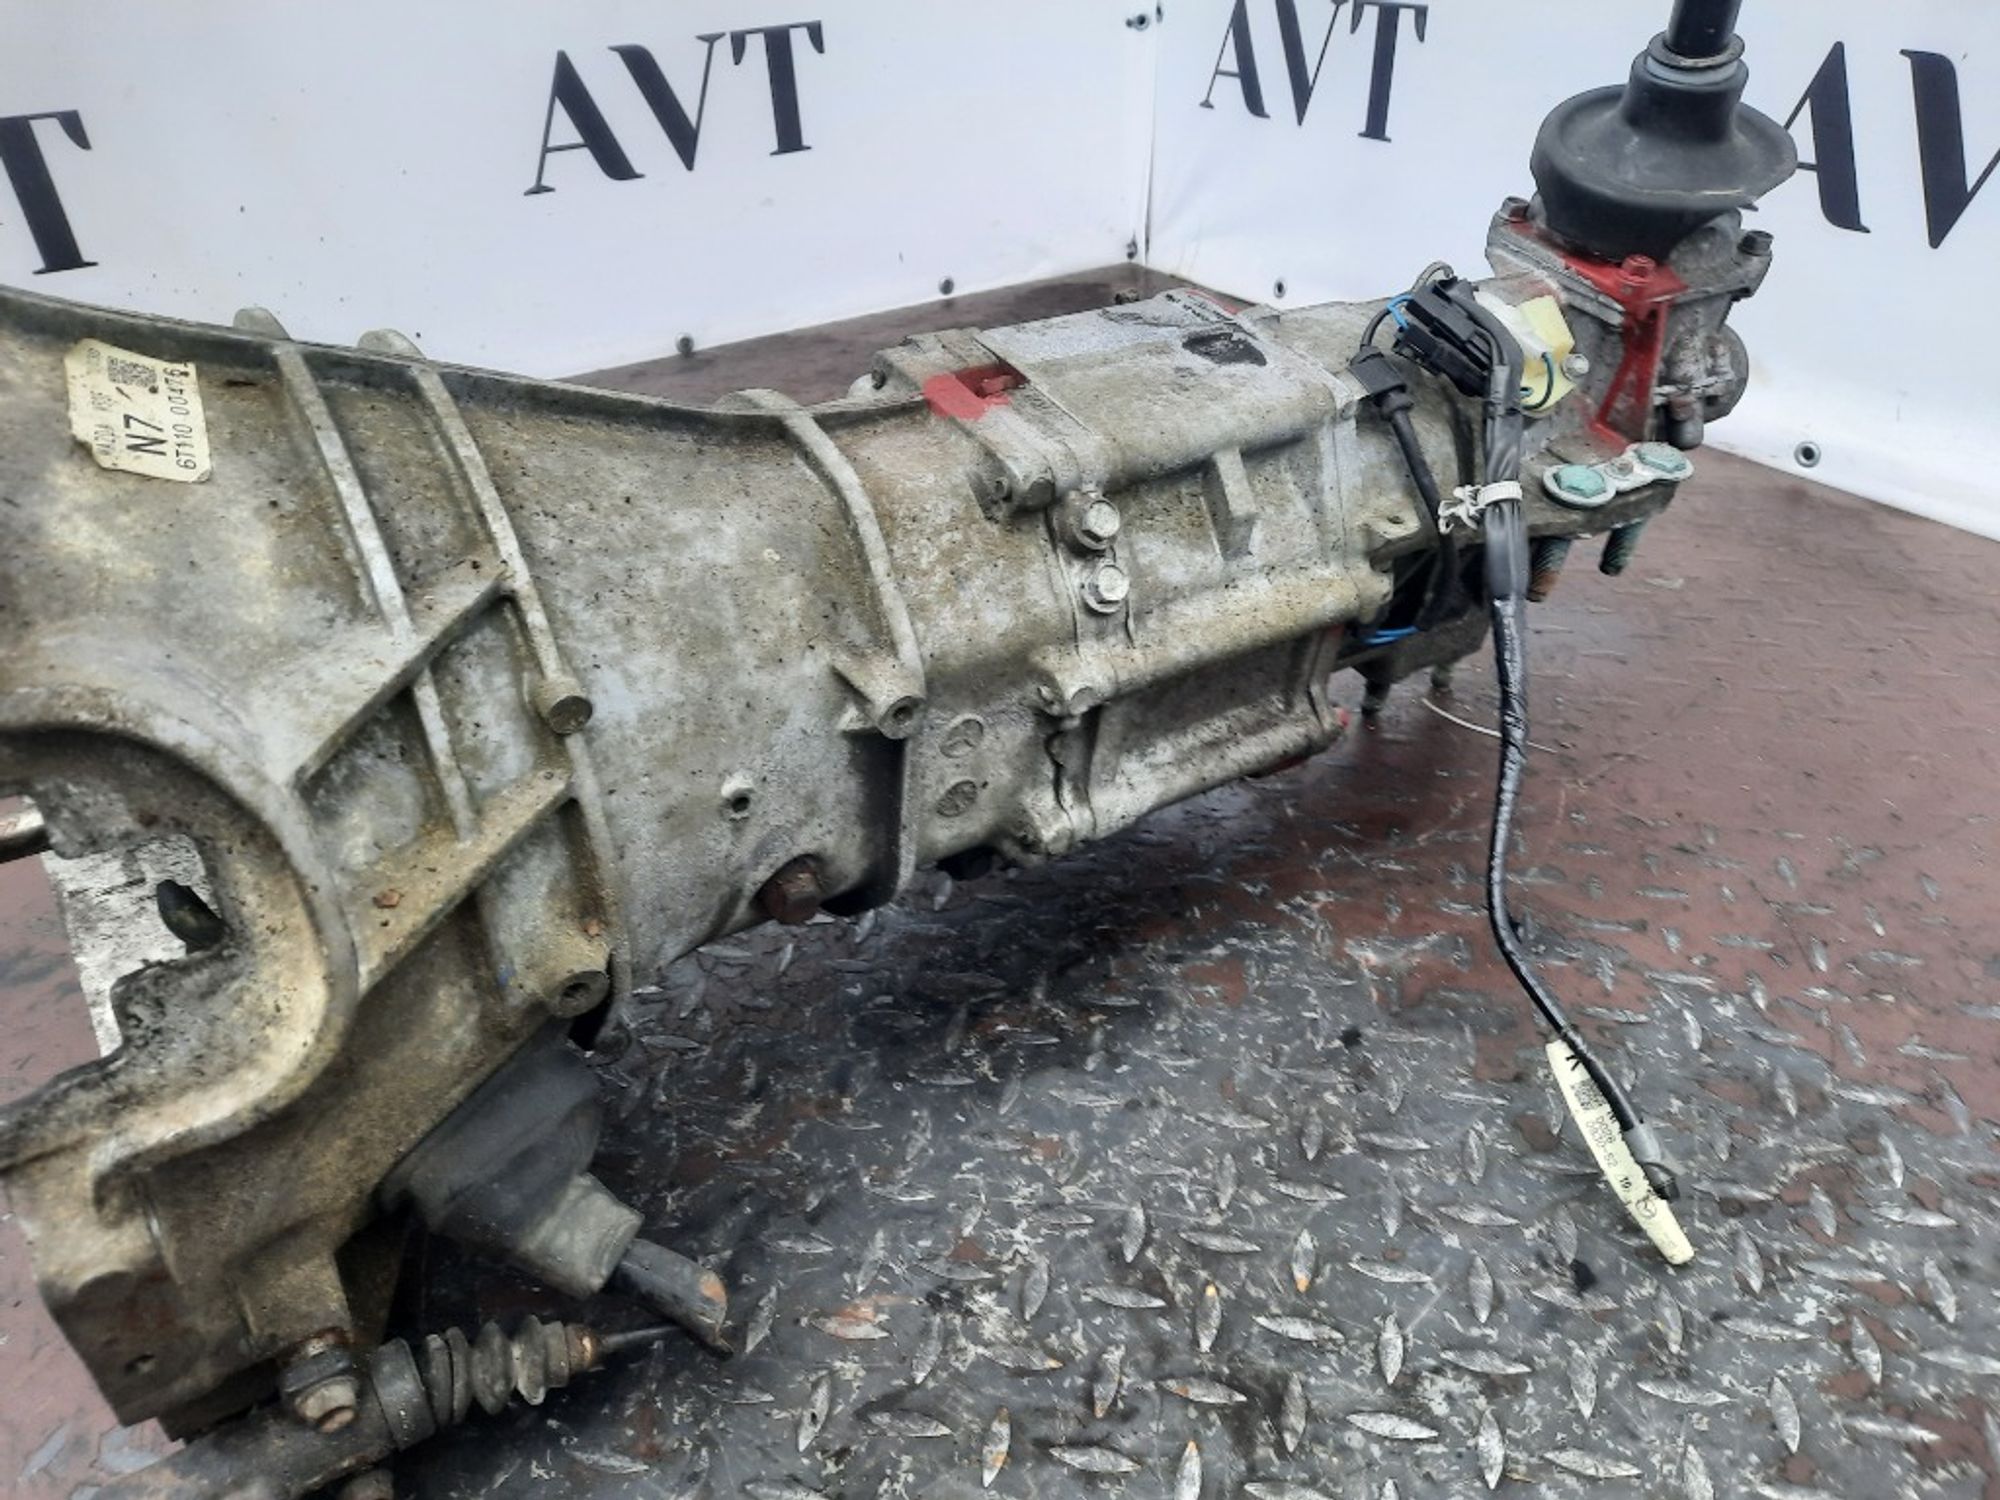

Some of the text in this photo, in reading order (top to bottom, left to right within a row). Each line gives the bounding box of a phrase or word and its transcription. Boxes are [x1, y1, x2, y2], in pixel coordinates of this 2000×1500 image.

[523, 20, 826, 196] AVT
[1199, 0, 1429, 143] AVT
[122, 413, 168, 457] N7
